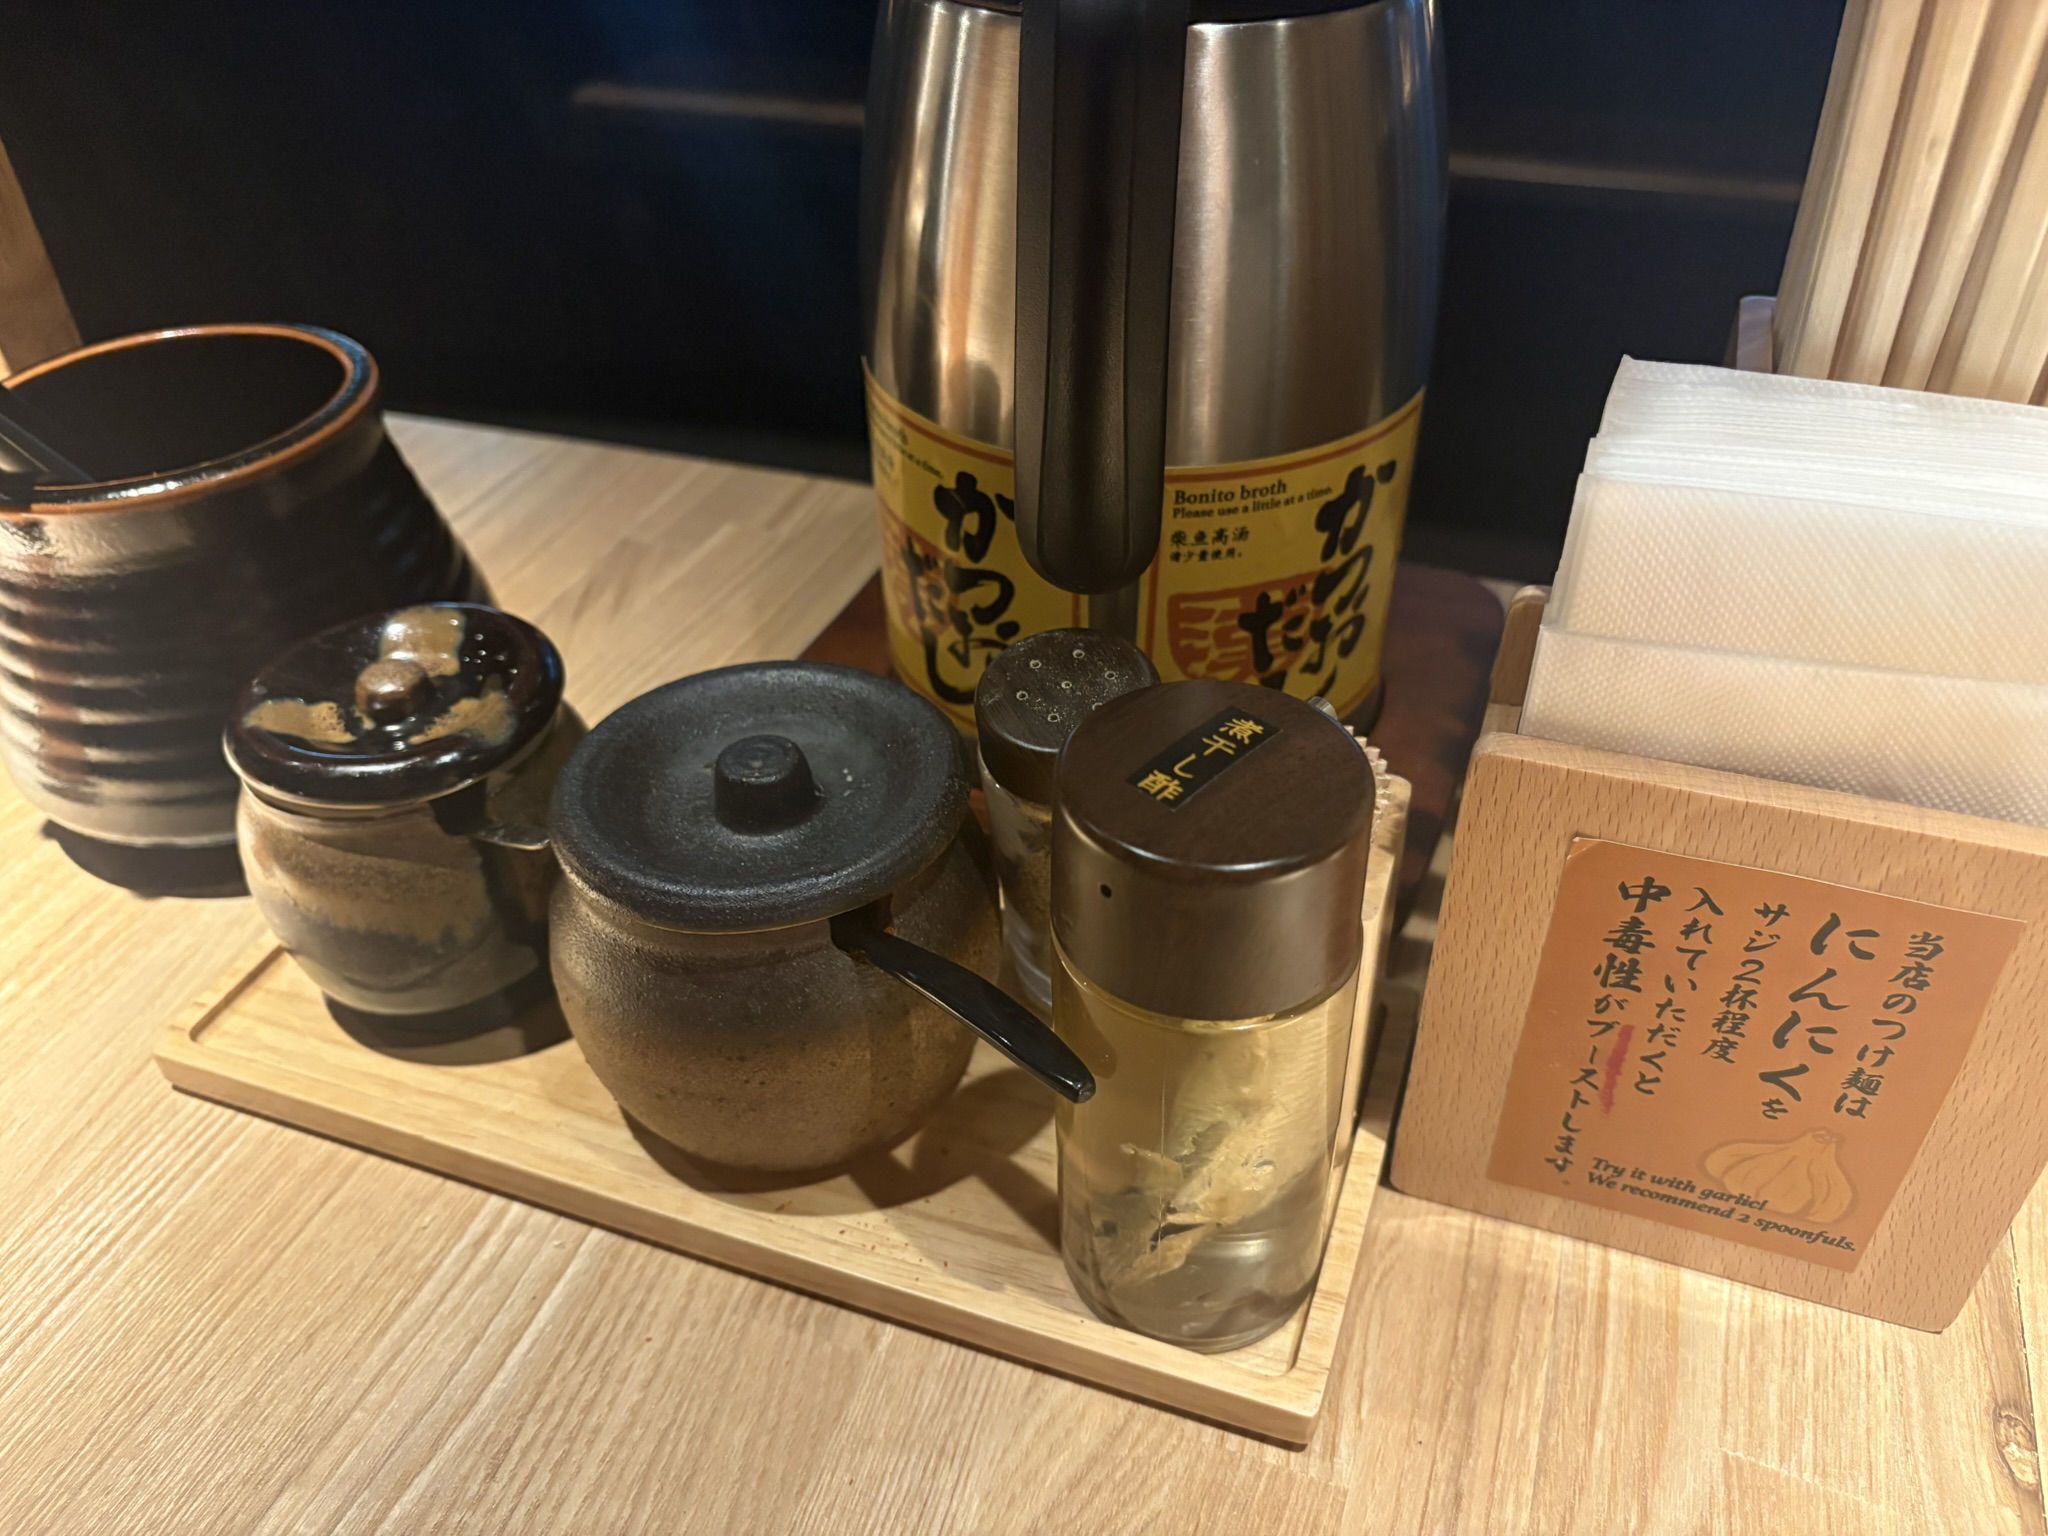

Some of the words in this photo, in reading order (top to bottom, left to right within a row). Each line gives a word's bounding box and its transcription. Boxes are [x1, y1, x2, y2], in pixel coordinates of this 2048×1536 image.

[1172, 507, 1214, 519] Please
[1217, 507, 1239, 517] use
[1241, 506, 1249, 514] a
[1252, 499, 1281, 513] little
[1283, 496, 1295, 507] at
[1174, 489, 1235, 505] Bonito
[1240, 479, 1287, 500] broth
[1137, 717, 1264, 801] 煮干し酢
[1634, 887, 1724, 1096] 入れていただくと
[1758, 912, 1880, 1120] にんにくを
[1833, 931, 1945, 1119] 当店のつけ麺は
[1587, 1171, 1618, 1190] We
[1620, 1182, 1736, 1218] recommend
[1737, 1212, 1751, 1224] 2
[1754, 1218, 1857, 1252] spoonfuls.
[1592, 1157, 1626, 1178] Try
[1630, 1166, 1647, 1180] it
[1650, 1173, 1697, 1194] with
